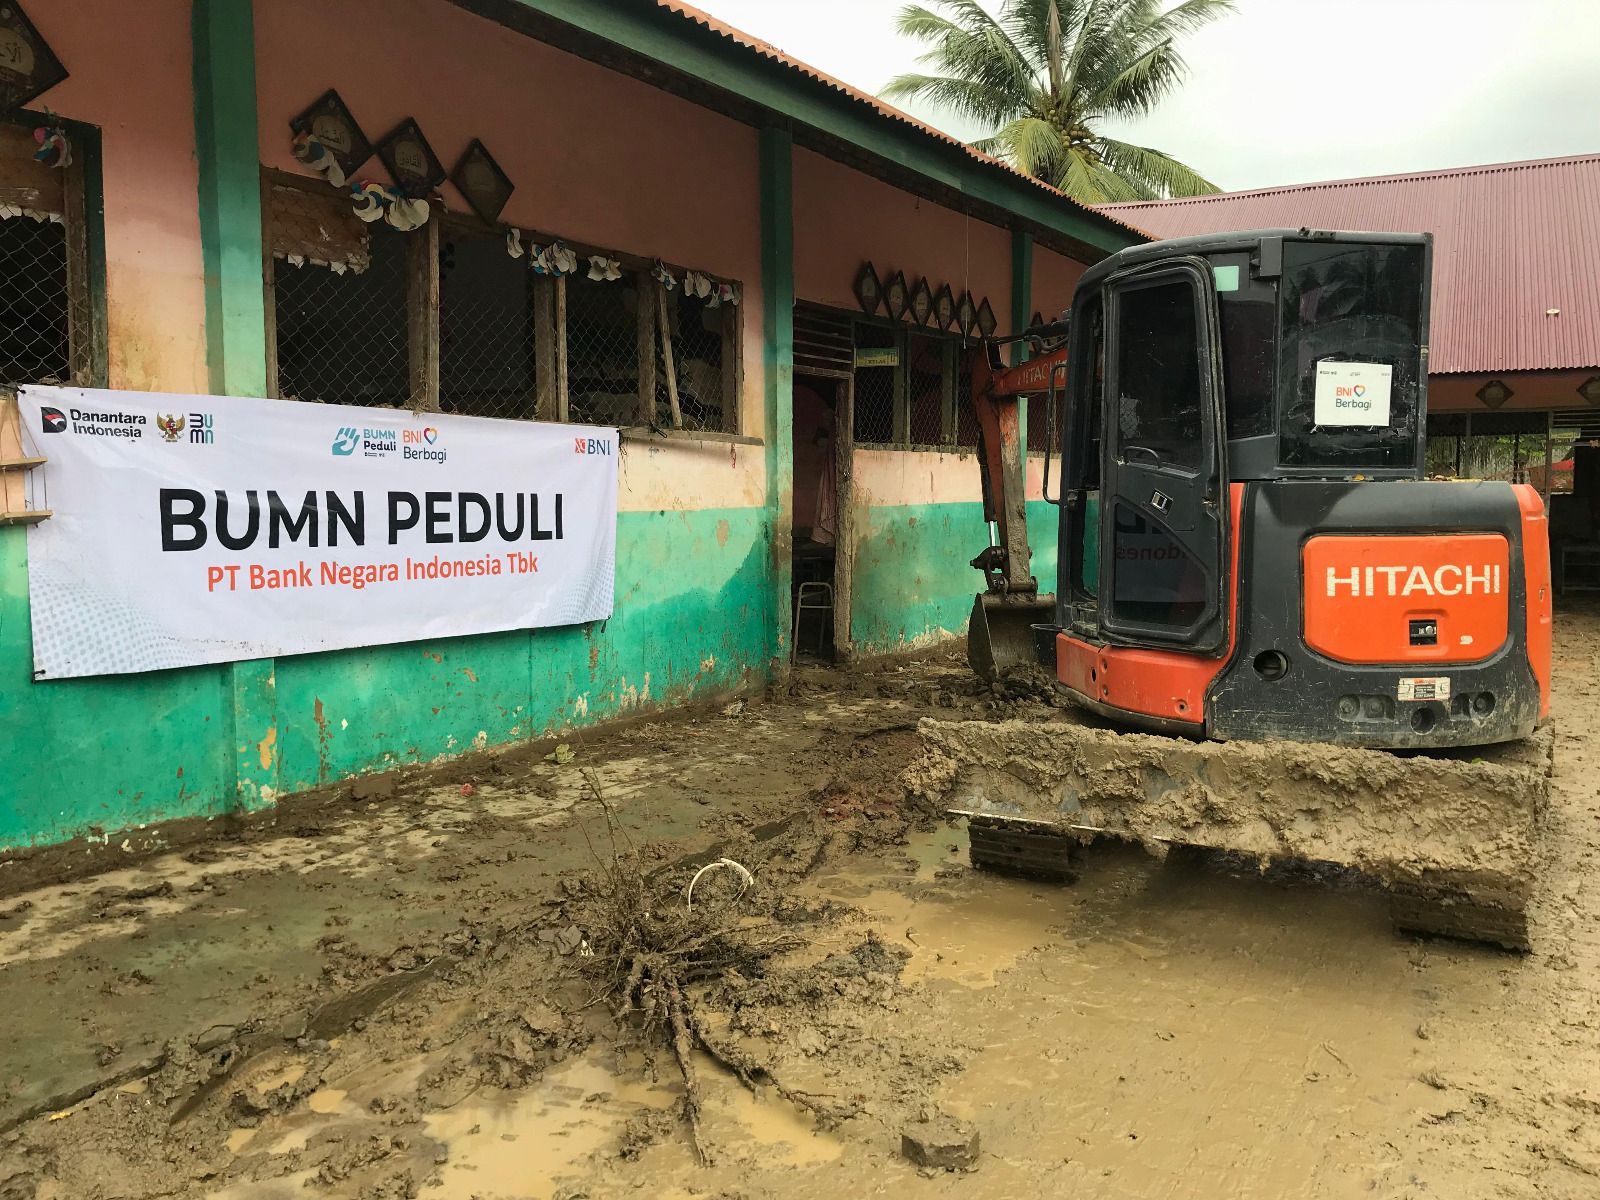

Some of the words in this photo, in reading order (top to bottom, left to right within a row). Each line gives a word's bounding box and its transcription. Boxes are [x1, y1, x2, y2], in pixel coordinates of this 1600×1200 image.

[1336, 387, 1352, 397] BNI
[1335, 398, 1372, 411] Berbagi
[69, 409, 147, 425] Danantara
[72, 422, 142, 438] Indonesia
[363, 428, 396, 440] BUMN
[402, 429, 422, 444] BNI
[363, 440, 397, 452] Peduli
[587, 438, 611, 456] BNI
[403, 446, 447, 464] Berbagi
[159, 488, 365, 551] BUMN
[388, 491, 564, 545] PEDULI
[207, 565, 241, 592] PT
[250, 561, 313, 590] Bank
[320, 560, 399, 590] Negara
[406, 552, 502, 583] Indonesia
[506, 551, 538, 574] Tbk
[1326, 564, 1500, 597] HITACHI
